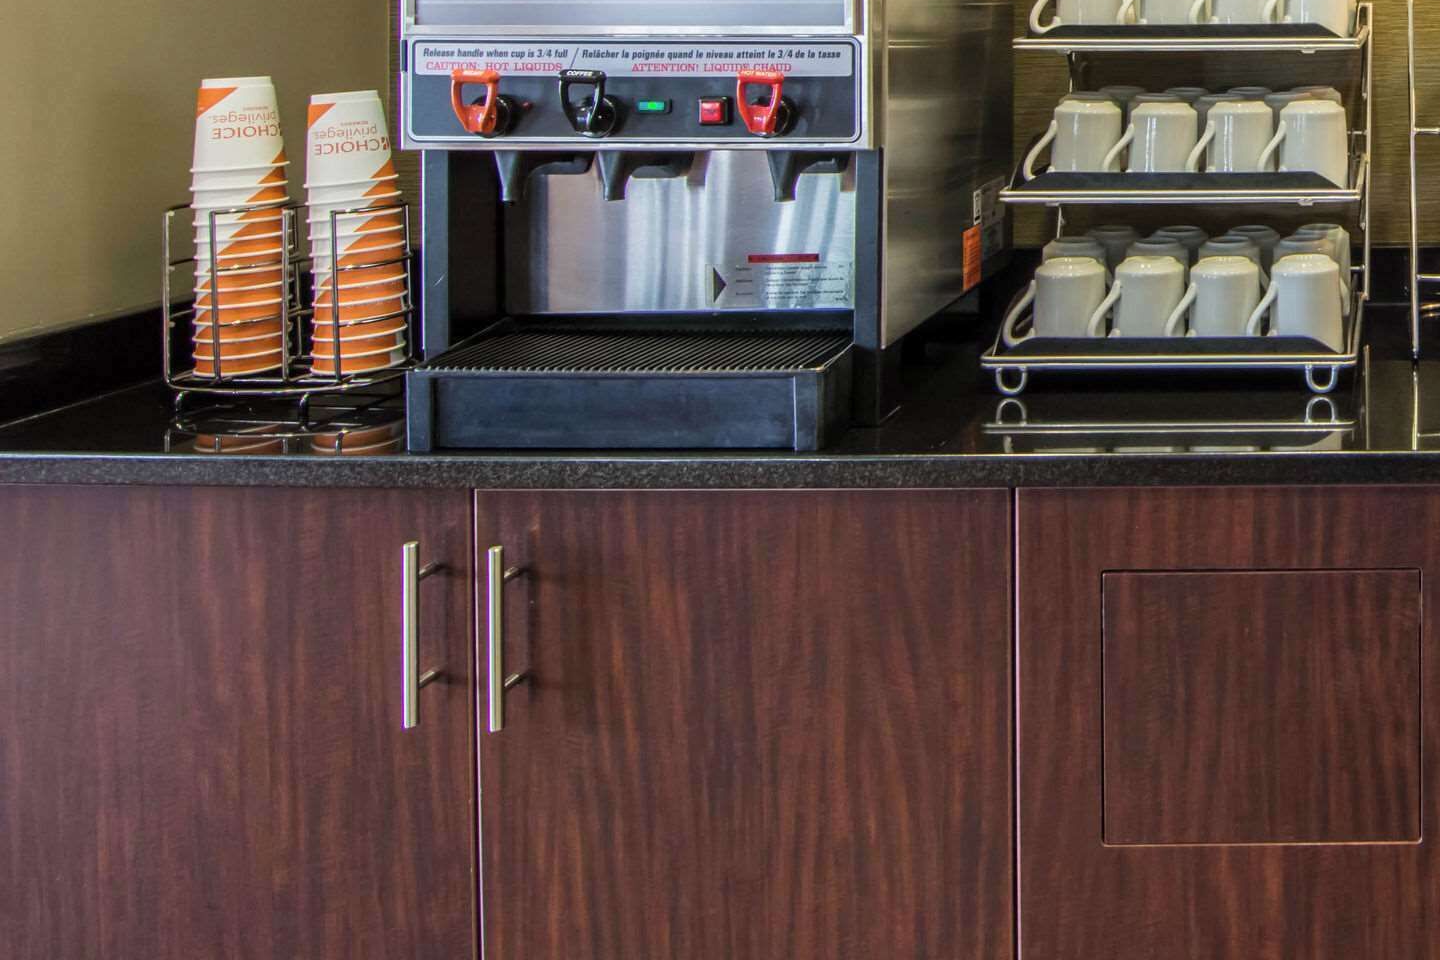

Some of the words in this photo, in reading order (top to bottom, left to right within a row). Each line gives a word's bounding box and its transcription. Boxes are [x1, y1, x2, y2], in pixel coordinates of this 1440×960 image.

[423, 48, 455, 58] Release
[457, 48, 484, 58] handle
[486, 48, 509, 58] when
[510, 50, 526, 59] cup
[527, 49, 535, 58] is
[536, 49, 553, 58] 3/4
[554, 49, 569, 58] full
[582, 48, 619, 58] Relâcher
[621, 49, 630, 58] la
[632, 49, 665, 60] poignée
[667, 49, 694, 60] quand
[695, 49, 704, 58] le
[705, 49, 734, 58] niveau
[736, 50, 765, 59] atteint
[767, 49, 776, 58] le
[777, 49, 793, 58] 3/4
[795, 50, 805, 58] de
[807, 49, 816, 58] la
[486, 62, 509, 71] HOT
[513, 62, 563, 71] LIQUIDS
[631, 63, 699, 72] ATTENTION!
[703, 63, 749, 72] LIQUIDE
[753, 63, 792, 72] CHAUD
[212, 124, 279, 140] CHOICE
[312, 123, 378, 139] privileges
[314, 138, 380, 156] CHOICE
